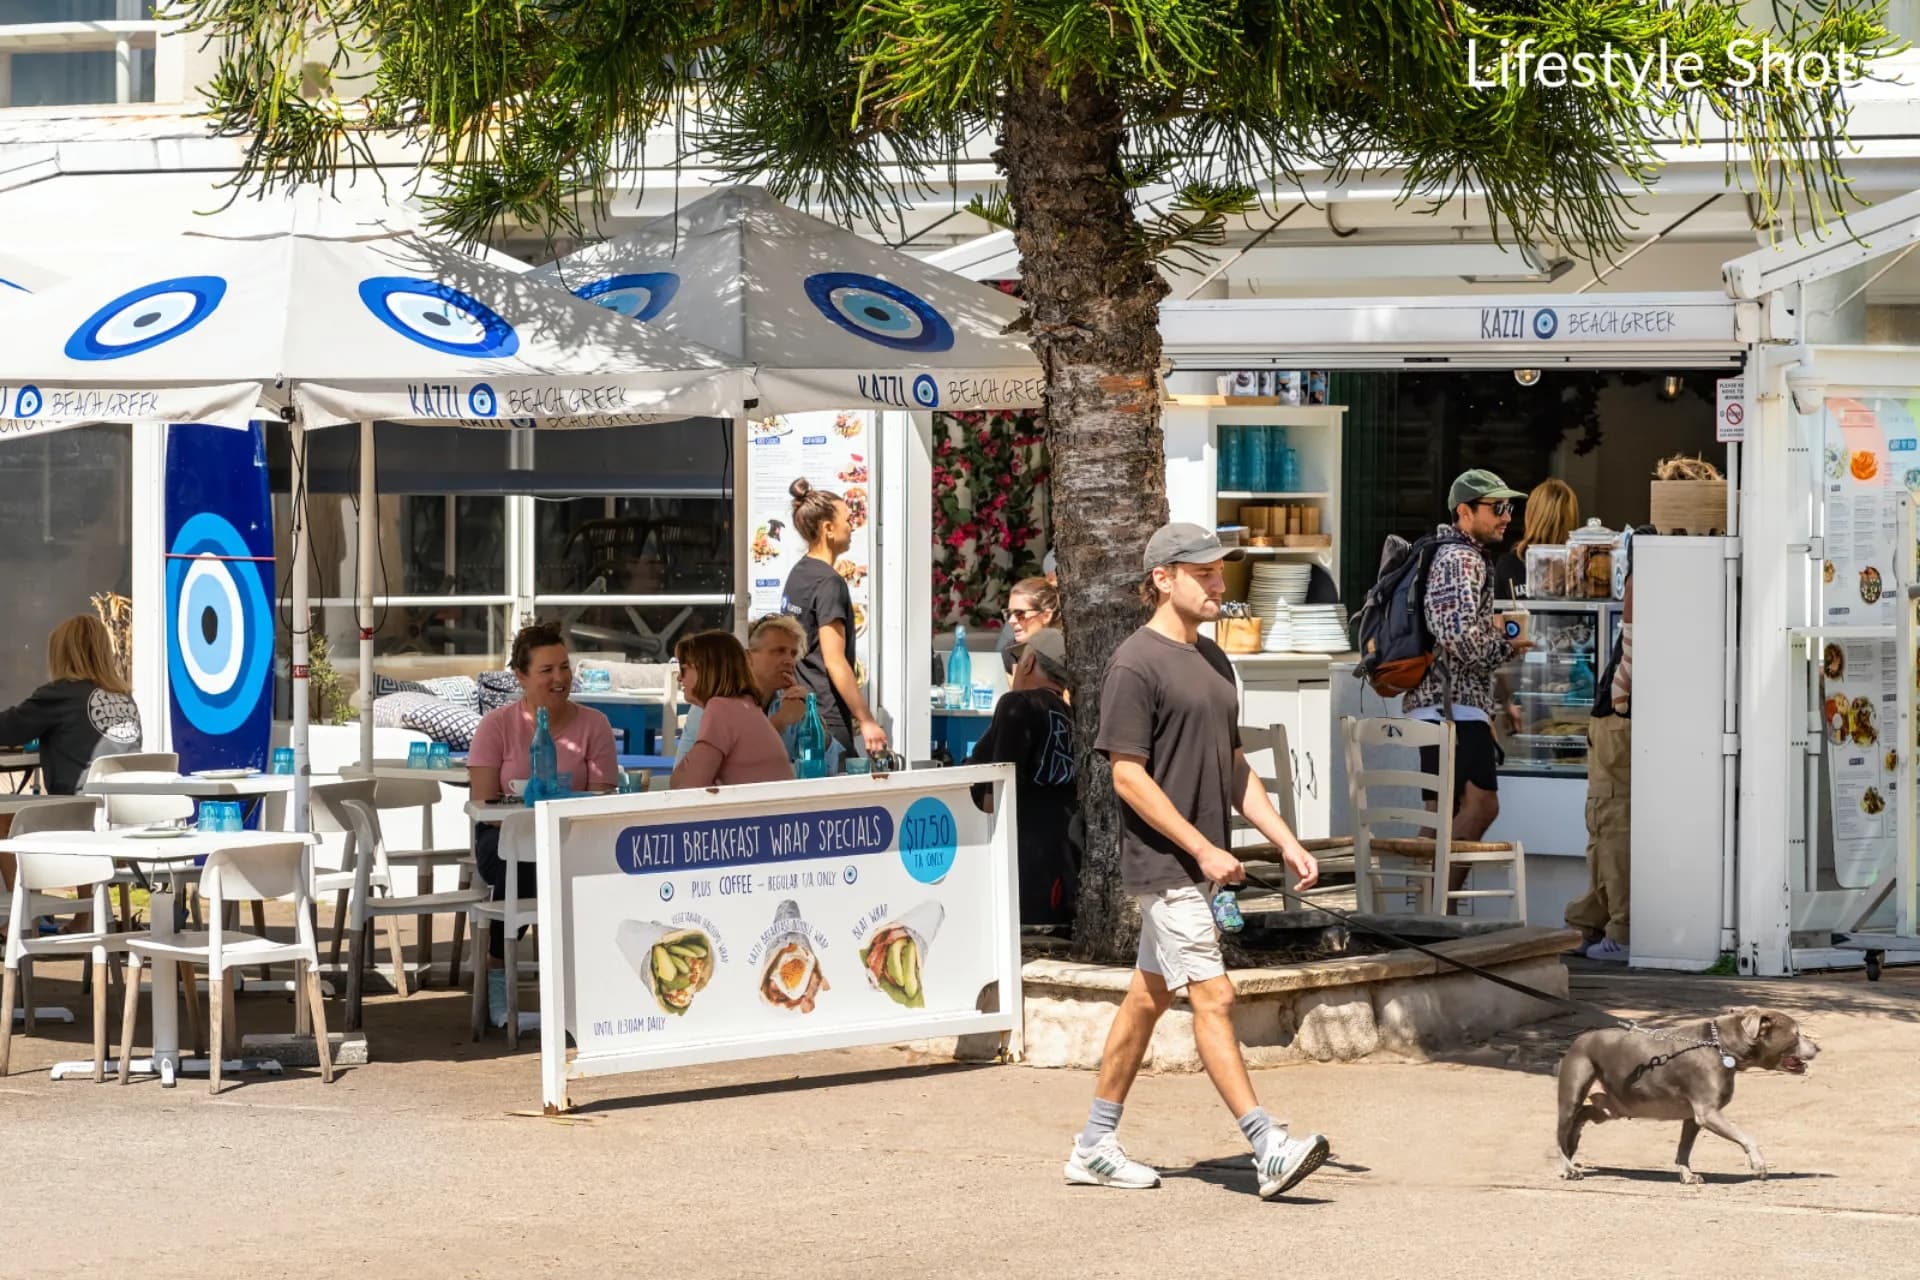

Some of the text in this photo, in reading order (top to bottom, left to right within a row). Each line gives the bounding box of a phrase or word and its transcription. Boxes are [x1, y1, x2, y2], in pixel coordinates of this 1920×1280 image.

[1481, 307, 1677, 339] KAZZI BEACH GREEK
[50, 391, 159, 417] BEACH GREEK
[407, 382, 627, 419] KAZZI BEACH GREEK
[858, 373, 1047, 408] KAZZI BEACH GREE
[631, 815, 881, 868] KAZZI BREAKFAST WRAP SPECIALS
[905, 814, 950, 855] $17.50
[914, 852, 944, 869] TA ONLY
[691, 880, 711, 898] PLUS
[719, 874, 753, 895] COFFEE
[767, 873, 799, 891] REGULAR
[816, 870, 837, 887] ONLY
[593, 1020, 614, 1036] UNTIL
[647, 1015, 666, 1032] DAILY
